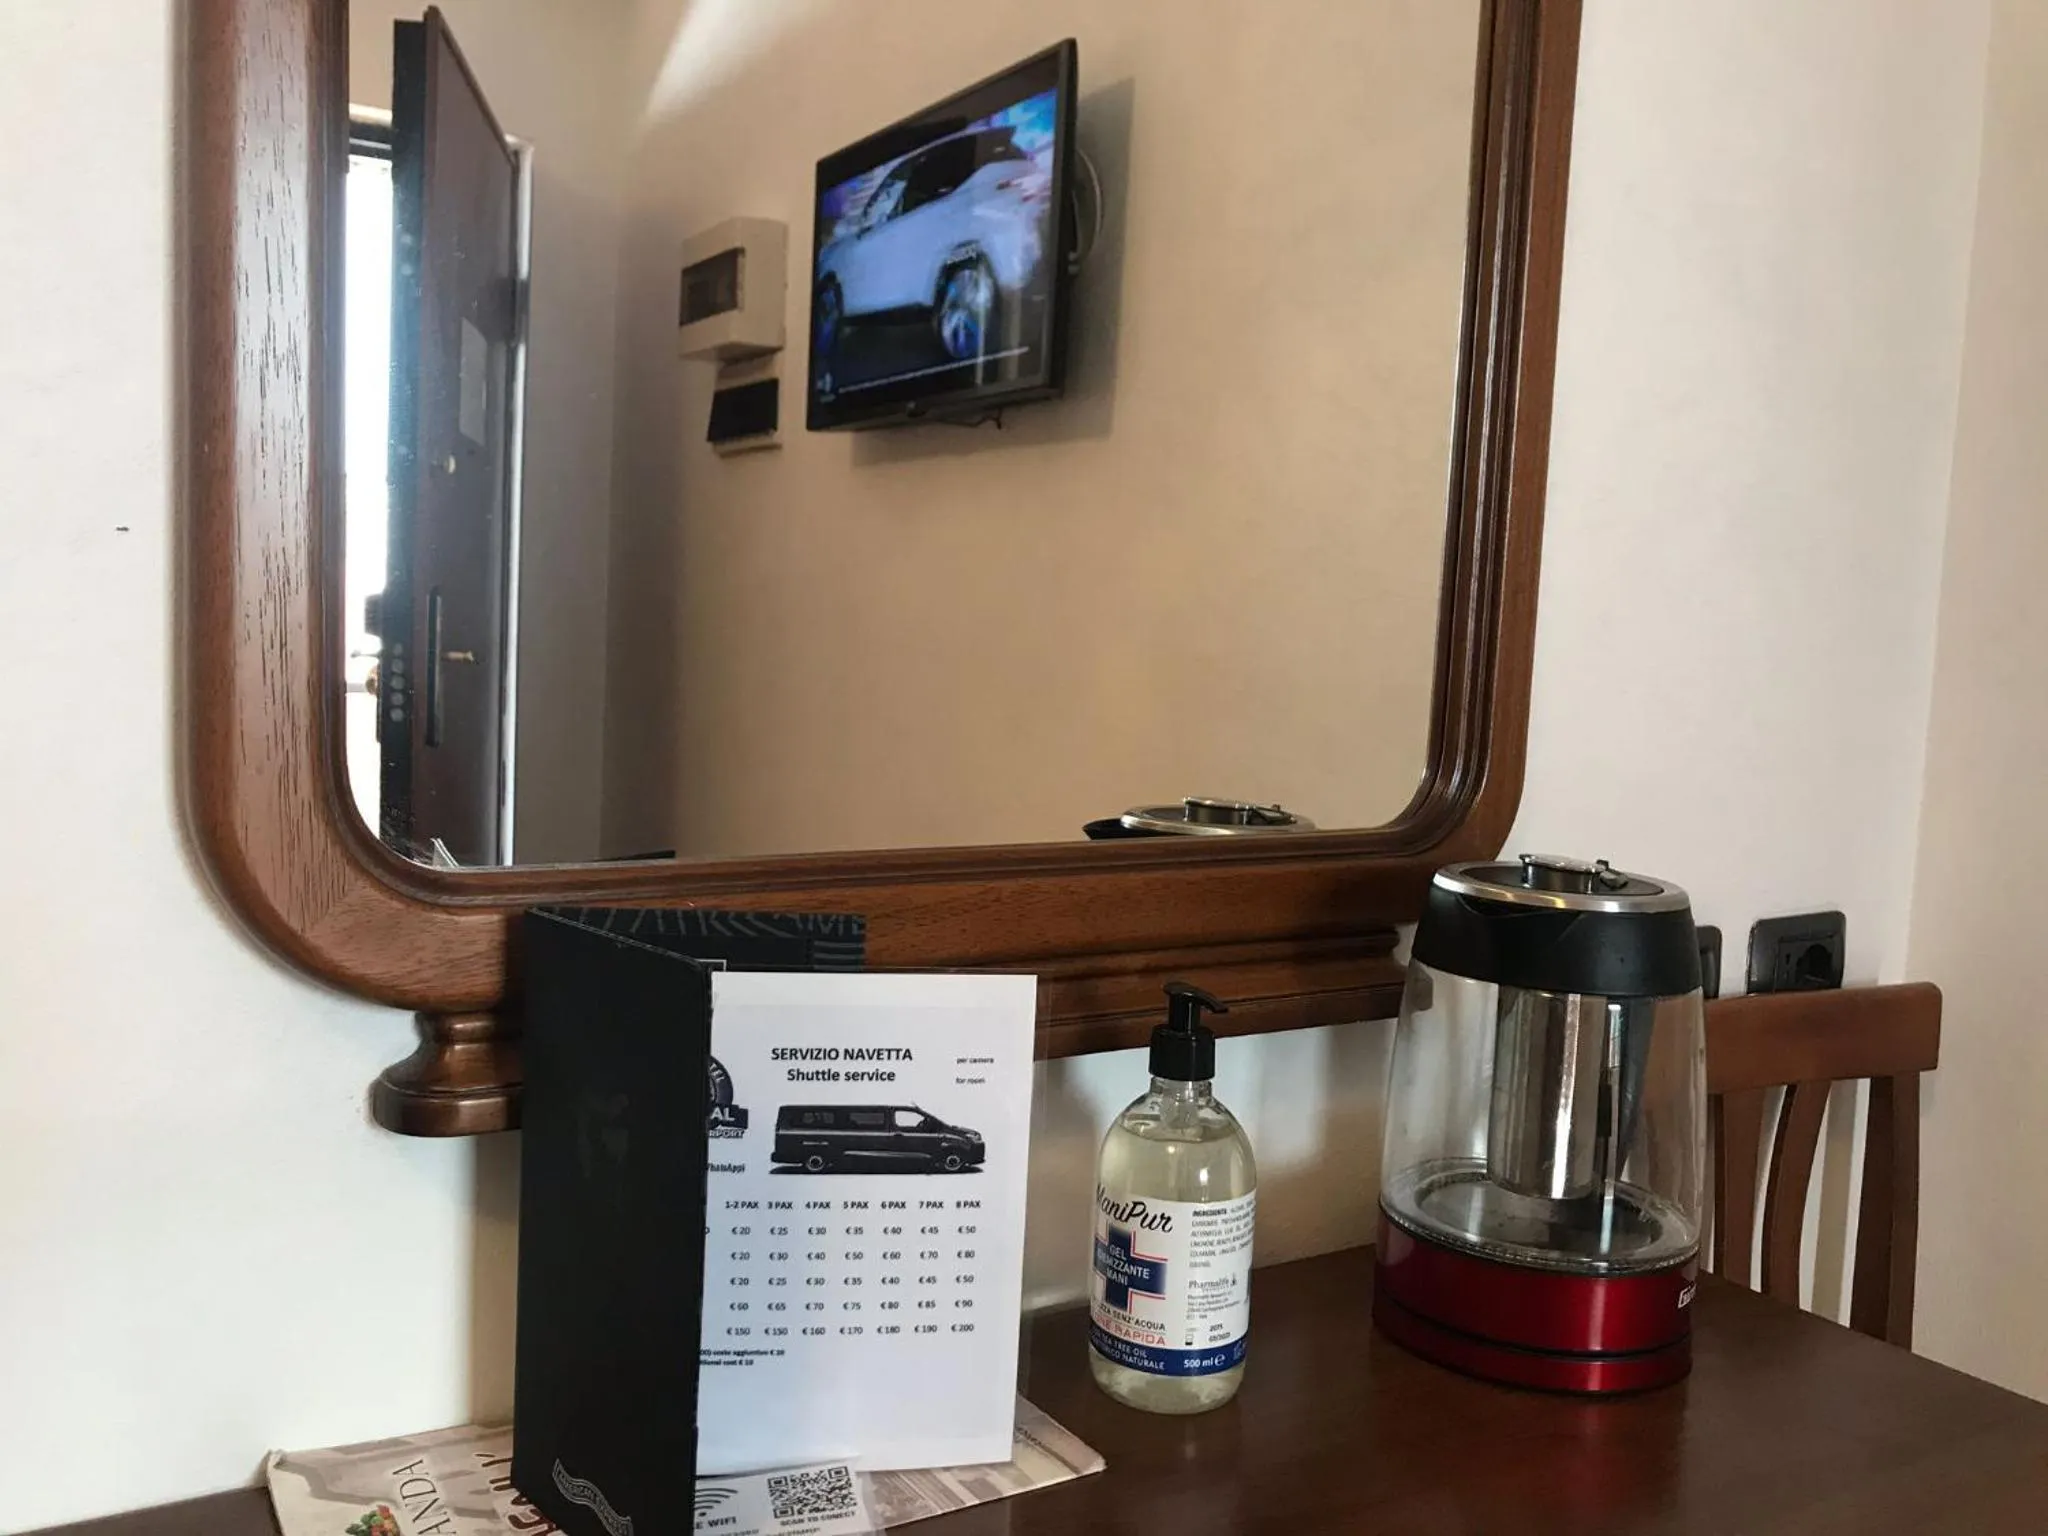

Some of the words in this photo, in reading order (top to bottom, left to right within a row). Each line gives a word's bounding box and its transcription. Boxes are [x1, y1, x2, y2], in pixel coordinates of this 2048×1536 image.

[771, 1048, 840, 1061] SERVIZIO
[843, 1048, 913, 1061] NAVETTA
[787, 1068, 840, 1082] Shuttle
[844, 1068, 896, 1082] service
[725, 1201, 739, 1209] 1-2
[741, 1201, 759, 1209] PAX
[775, 1201, 793, 1210] PAX
[813, 1201, 831, 1209] PAX
[850, 1201, 869, 1209] PAX
[888, 1201, 906, 1209] PAX
[926, 1201, 944, 1209] PAX
[963, 1200, 981, 1208] PAX
[739, 1226, 751, 1236] 20
[777, 1226, 788, 1236] 25
[853, 1226, 864, 1235] 35
[890, 1226, 902, 1235] 40
[928, 1226, 939, 1235] 45
[965, 1225, 976, 1234] 50
[738, 1251, 750, 1261] 20
[814, 1251, 826, 1261] 40
[852, 1251, 864, 1260] 50
[928, 1250, 939, 1260] 70
[738, 1277, 749, 1286] 20
[775, 1277, 787, 1286] 25
[851, 1277, 862, 1286] 35
[888, 1276, 900, 1285] 40
[925, 1276, 937, 1285] 45
[963, 1274, 975, 1284] 50
[774, 1302, 786, 1311] 65
[813, 1302, 825, 1311] 70
[851, 1302, 862, 1310] 75
[925, 1300, 936, 1309] 85
[961, 1299, 973, 1308] 90
[847, 1326, 864, 1335] 170
[958, 1323, 975, 1332] 200
[1183, 1358, 1201, 1368] 500
[1202, 1357, 1213, 1367] ml
[708, 1516, 737, 1528] WIFI
